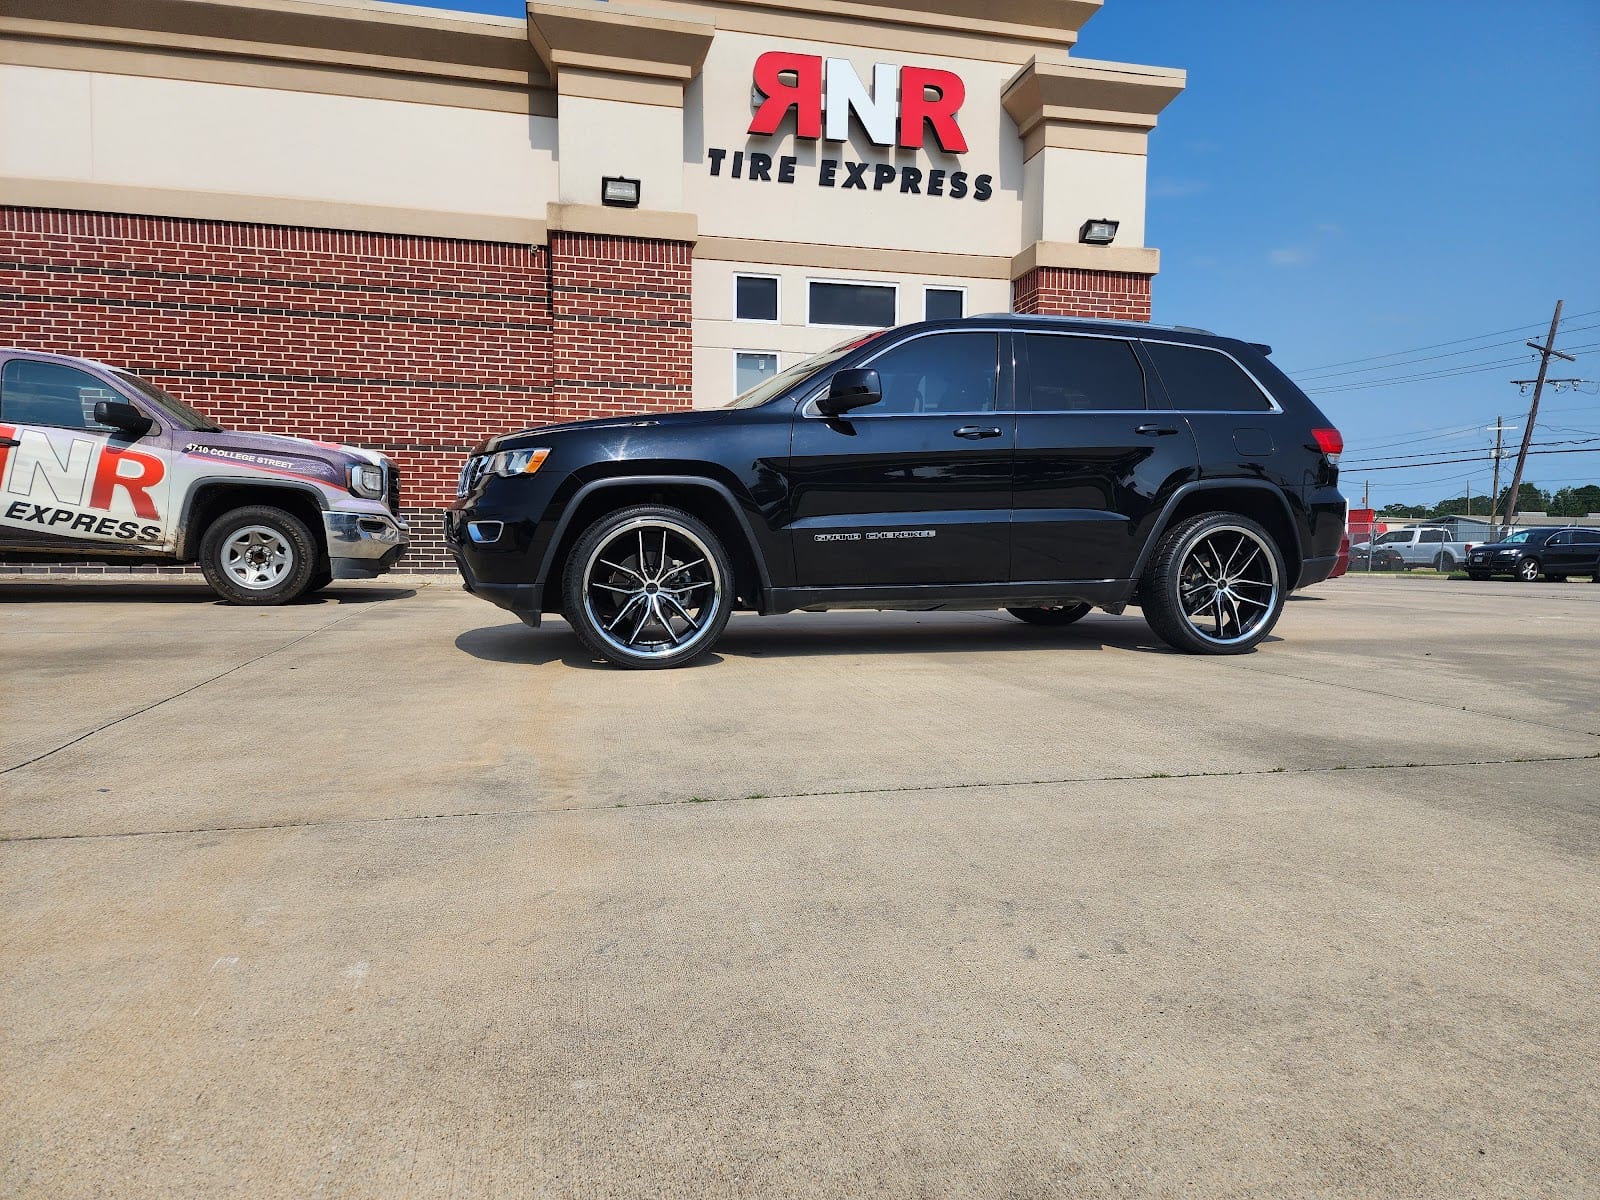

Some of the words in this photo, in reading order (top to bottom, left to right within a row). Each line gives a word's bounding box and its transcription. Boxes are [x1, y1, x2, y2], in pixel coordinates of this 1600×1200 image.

[708, 148, 797, 184] TIRE
[818, 159, 993, 201] EXPRESS
[0, 423, 166, 521] NR
[186, 443, 208, 454] 4710
[210, 448, 255, 462] COLLEGE
[256, 457, 294, 469] STREET
[4, 500, 162, 543] EXPRESS
